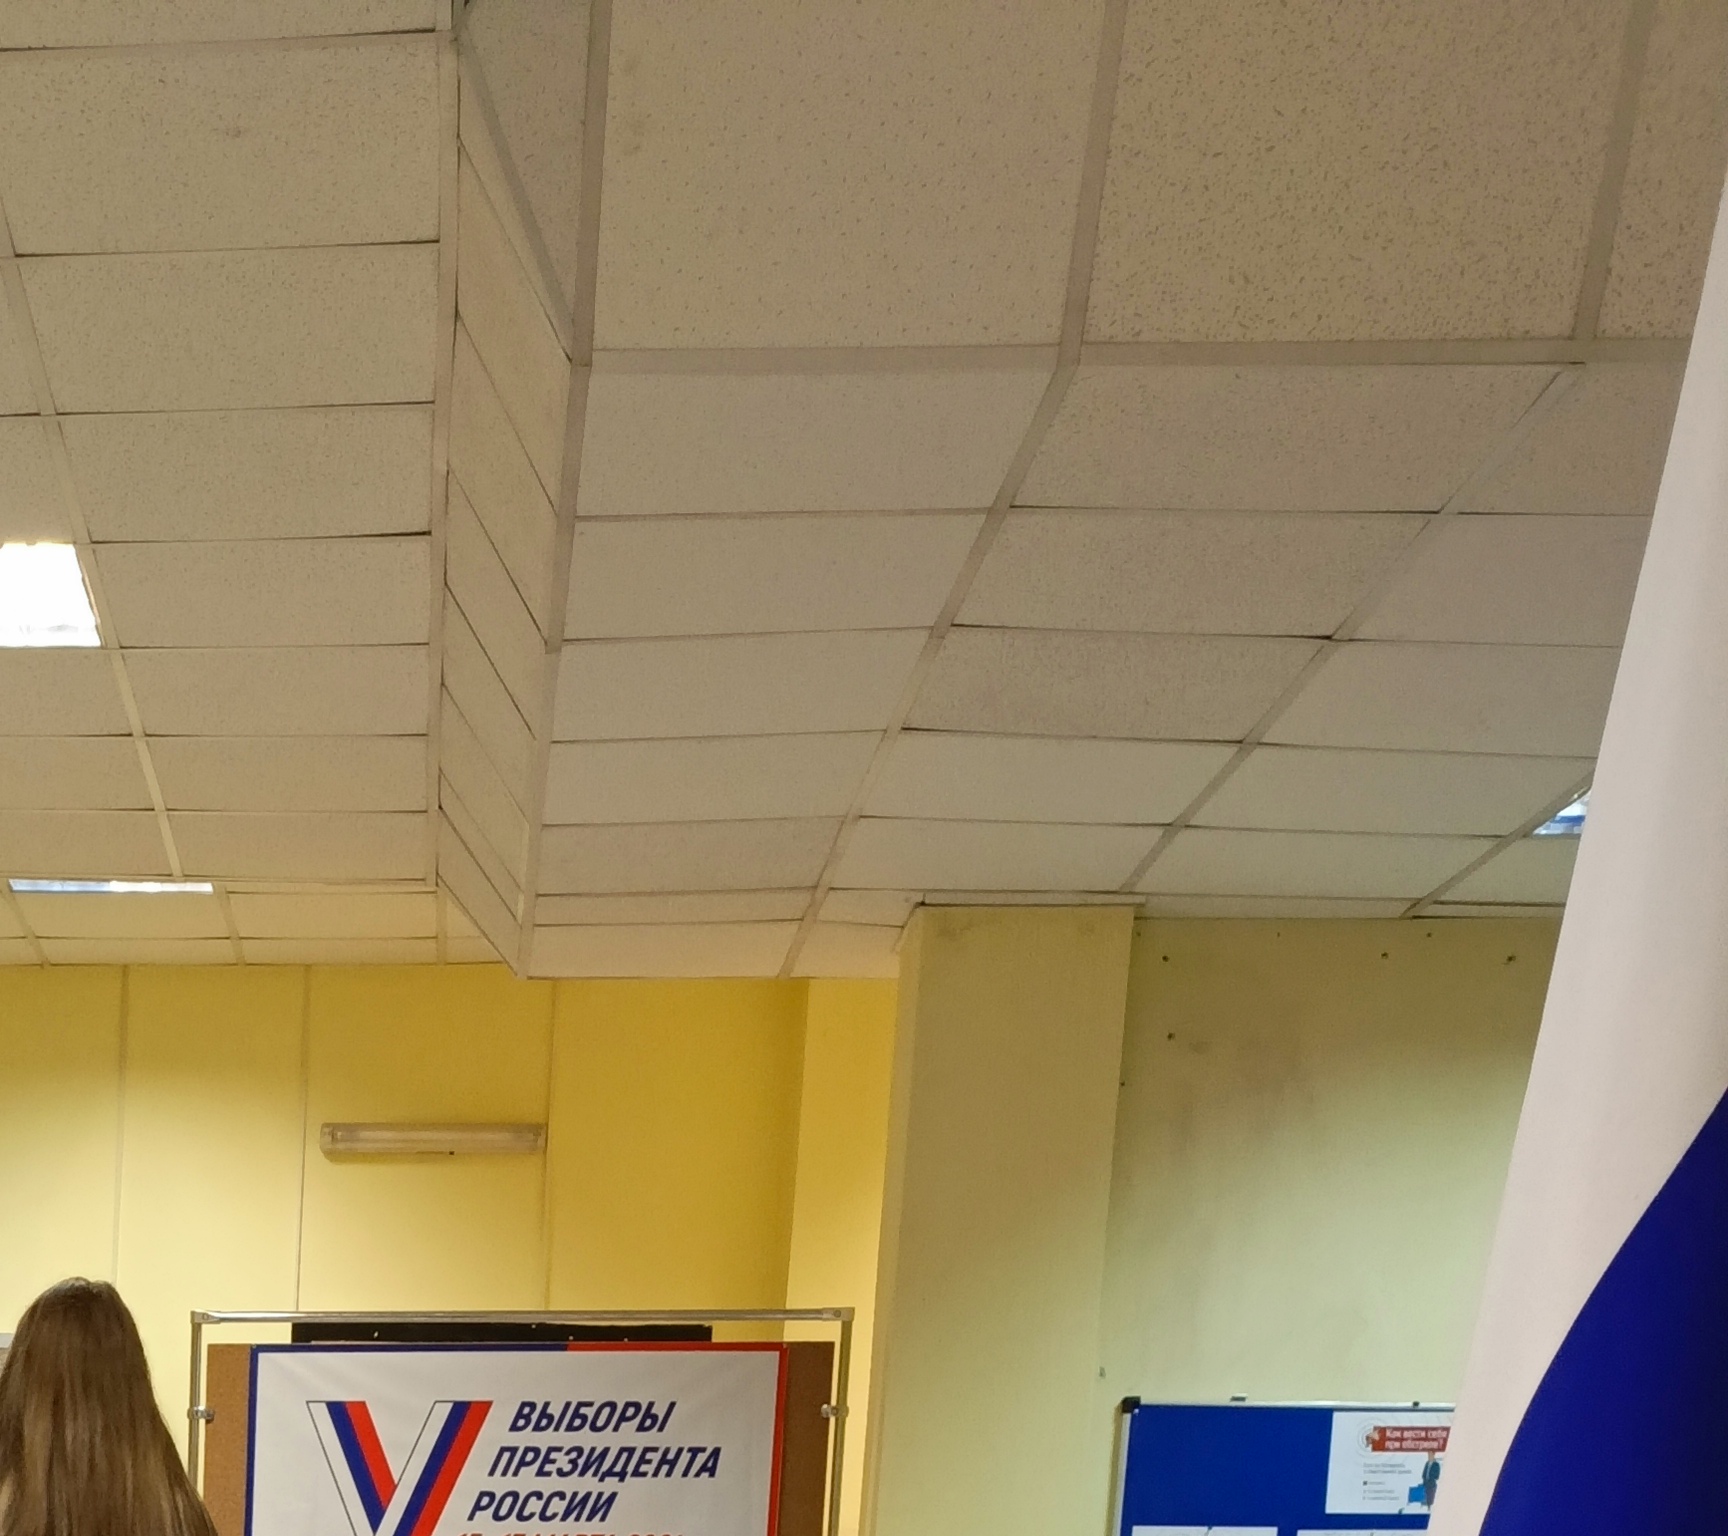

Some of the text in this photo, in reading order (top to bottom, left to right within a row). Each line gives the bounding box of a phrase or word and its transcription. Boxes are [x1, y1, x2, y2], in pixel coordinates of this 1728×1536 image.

[508, 1401, 677, 1433] ВЫБОРЫ
[487, 1446, 722, 1483] ПРЕЗИДЕНТА
[467, 1490, 619, 1523] РОССИИ
